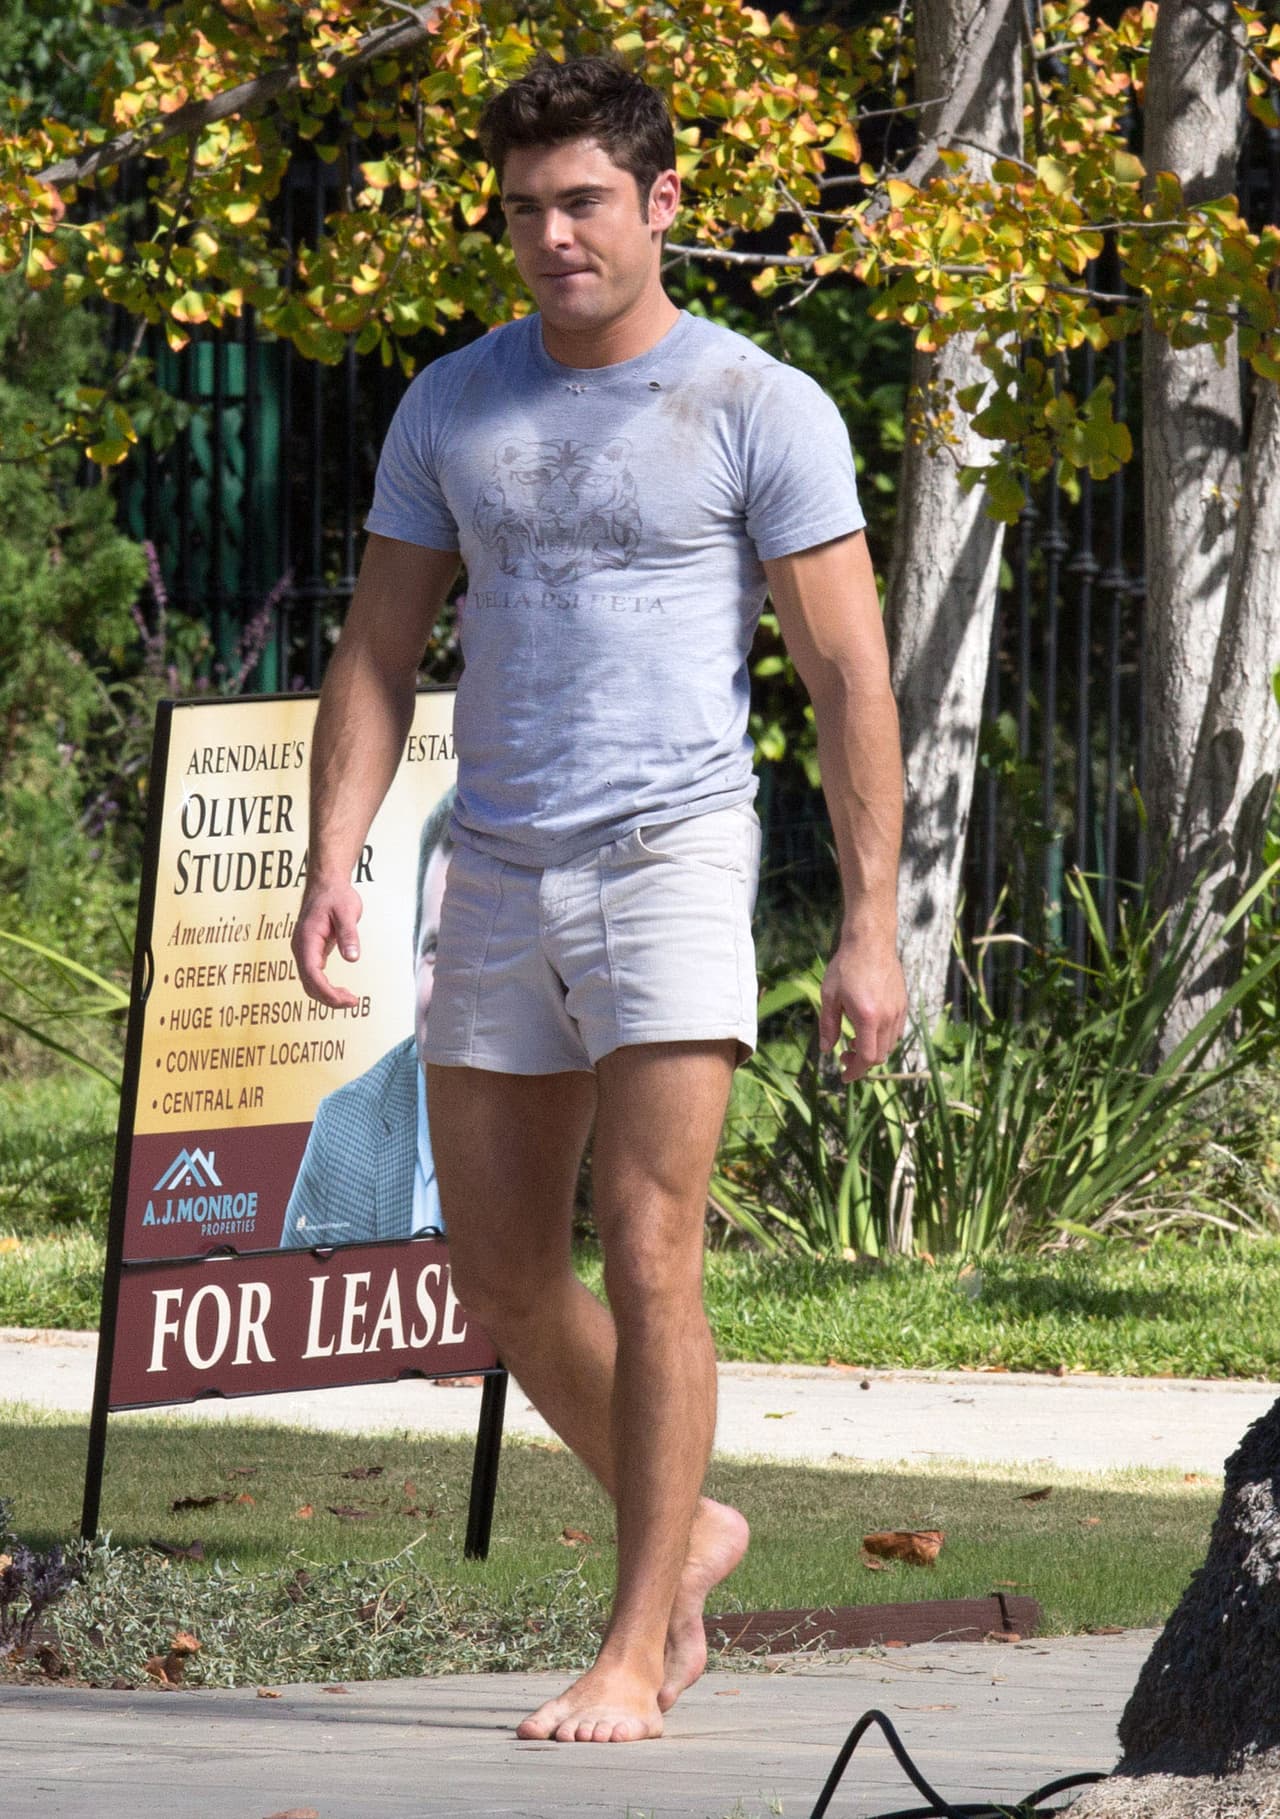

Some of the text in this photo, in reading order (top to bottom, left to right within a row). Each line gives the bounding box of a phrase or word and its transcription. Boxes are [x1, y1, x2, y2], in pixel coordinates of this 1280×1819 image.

[541, 591, 580, 610] PSI
[186, 740, 305, 775] ARENDALE'S
[181, 793, 295, 840] OLIVER
[173, 844, 375, 896] STUDEBAR
[167, 912, 294, 947] Amenities Incl
[174, 959, 296, 989] GREEK FRIENDL
[169, 1006, 213, 1031] HUGE
[219, 1000, 303, 1028] 10-PERSON
[166, 1039, 346, 1073] CONVENIENT LOCATION
[162, 1085, 265, 1115] CENTRAL AIR
[201, 1219, 256, 1237] PROPERTIES
[146, 1263, 468, 1373] FOR LEASE
